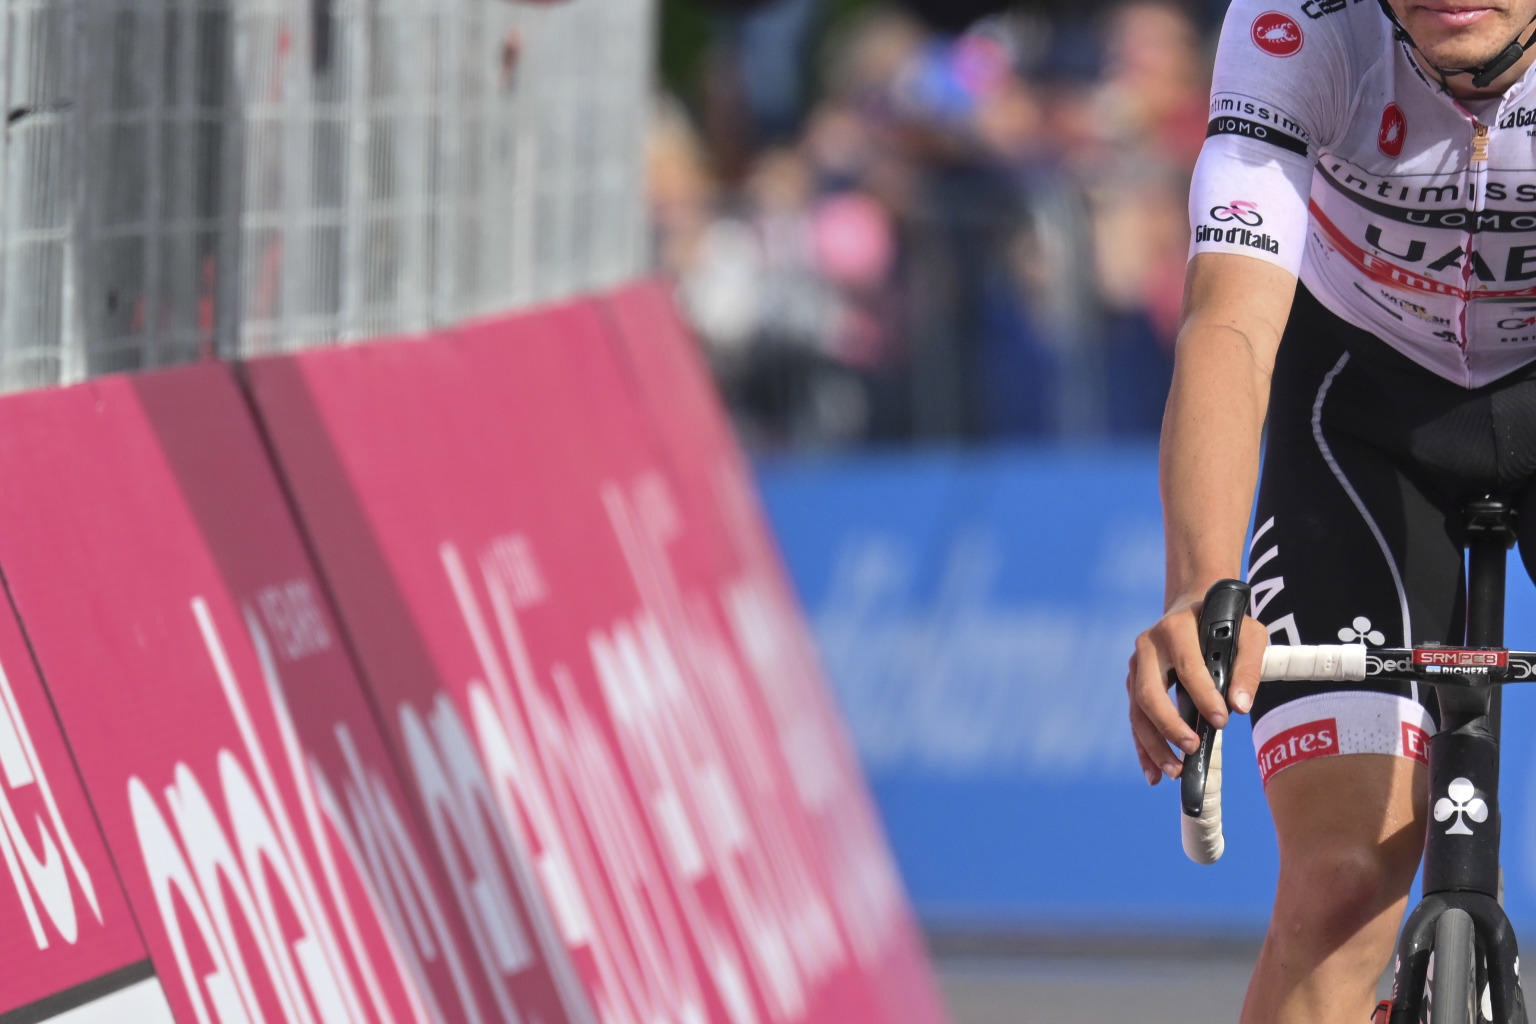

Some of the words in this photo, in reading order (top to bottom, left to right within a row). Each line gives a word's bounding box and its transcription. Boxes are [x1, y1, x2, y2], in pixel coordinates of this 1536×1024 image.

[1218, 119, 1268, 138] UOMO
[1196, 225, 1223, 243] Giro
[1225, 227, 1279, 254] d'Italia
[1421, 652, 1457, 663] SRM
[1259, 730, 1333, 776] irates
